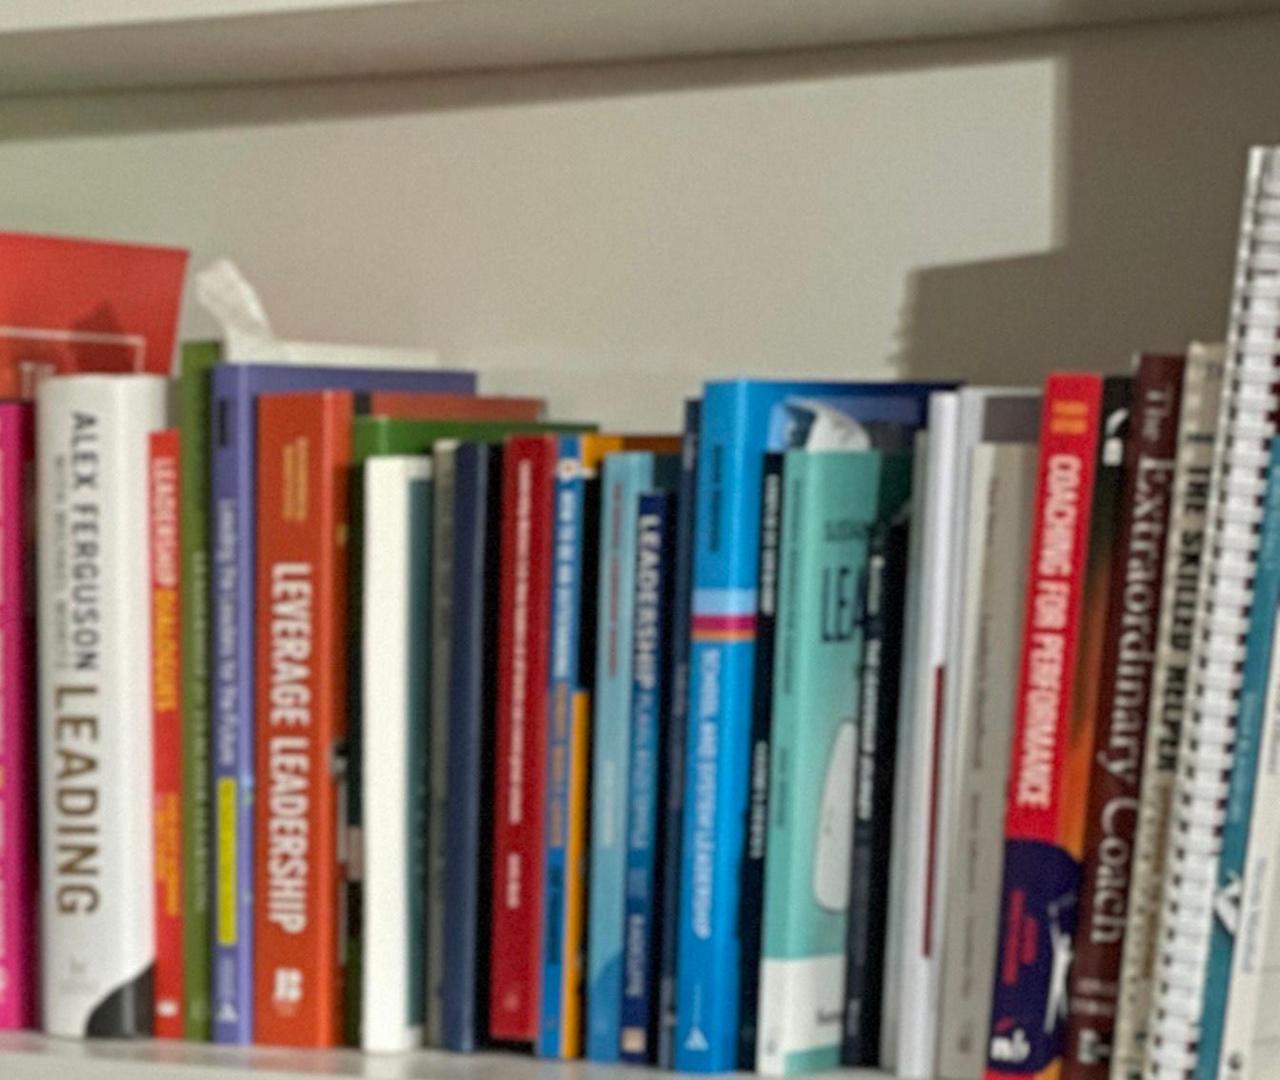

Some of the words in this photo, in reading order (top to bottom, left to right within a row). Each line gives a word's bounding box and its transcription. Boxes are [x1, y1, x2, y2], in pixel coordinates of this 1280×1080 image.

[72, 411, 98, 491] ALEX
[1142, 389, 1172, 445] The
[153, 456, 177, 588] LEADERSHIP
[1039, 453, 1081, 576] COACHING
[1185, 465, 1209, 514] THE
[71, 504, 99, 672] FERGUSON
[271, 561, 312, 727] LEVERAGE
[634, 512, 662, 689] LEADERSHIP
[1034, 579, 1069, 629] FOR
[1097, 455, 1175, 785] Extraordinary
[1170, 529, 1207, 658] SKILLED
[1019, 632, 1065, 809] PERFORMANCE
[1157, 667, 1190, 772] HELPER
[53, 684, 99, 917] LEADING
[268, 736, 311, 934] LEADERSHIP
[1091, 799, 1137, 943] Coach
